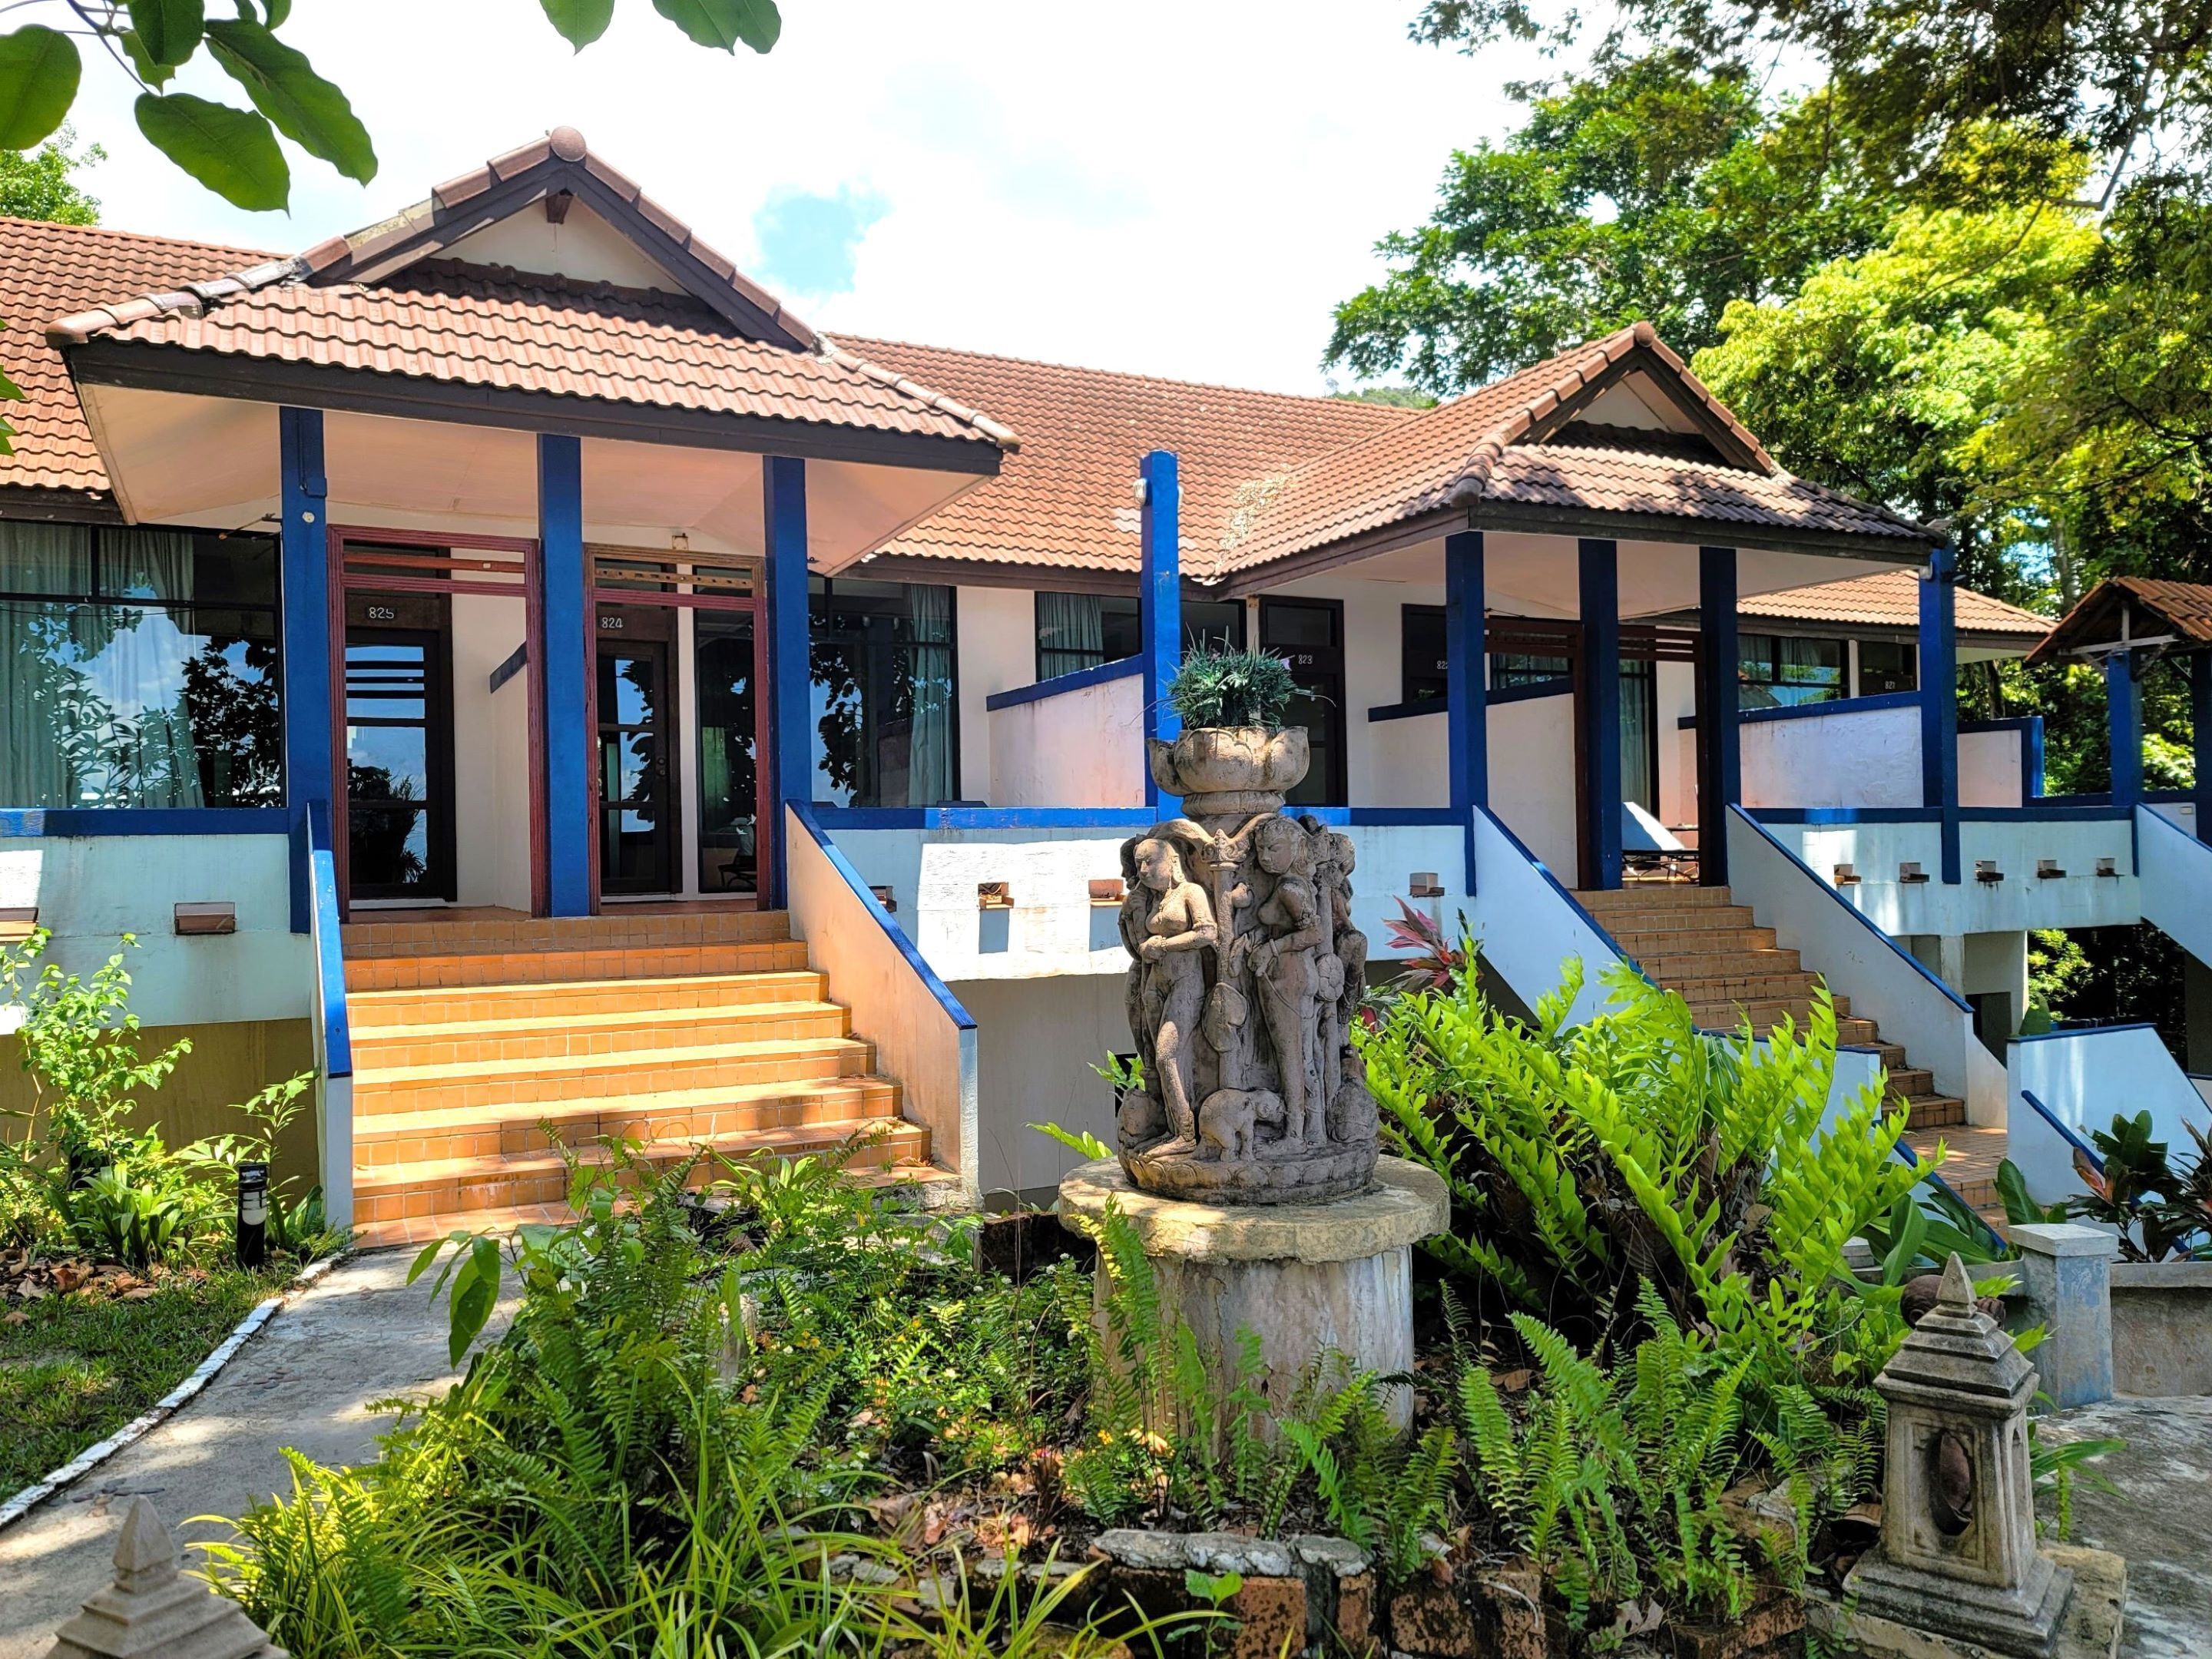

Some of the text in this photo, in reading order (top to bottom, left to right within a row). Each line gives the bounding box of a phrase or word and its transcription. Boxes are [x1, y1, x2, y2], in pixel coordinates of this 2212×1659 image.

[369, 607, 395, 619] 825
[601, 617, 624, 628] 824
[1298, 654, 1313, 664] 823
